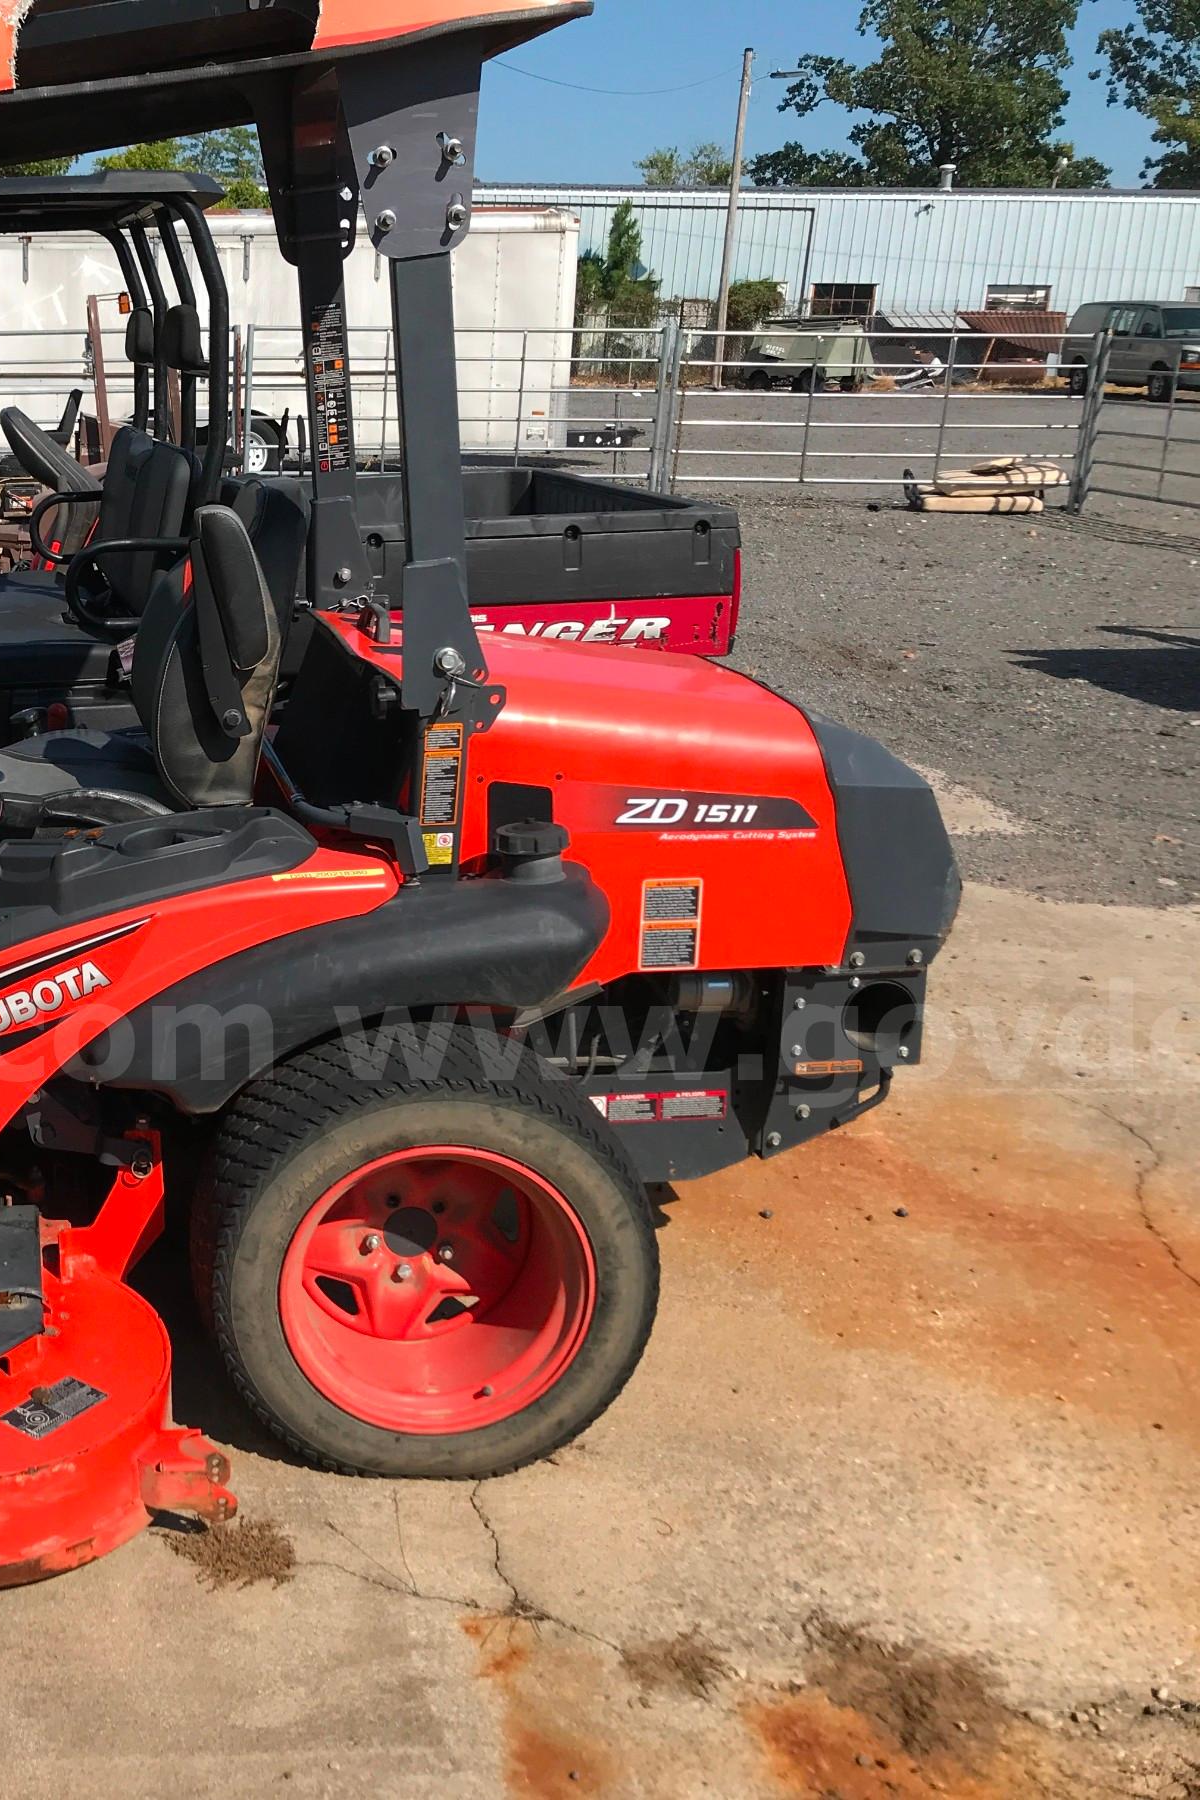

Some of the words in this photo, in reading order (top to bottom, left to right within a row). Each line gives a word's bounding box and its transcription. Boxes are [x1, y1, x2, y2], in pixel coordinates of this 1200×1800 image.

[474, 617, 672, 642] NGER
[615, 798, 689, 824] ZD
[693, 804, 759, 823] 1511
[659, 832, 729, 841] Aerodynamic
[733, 831, 774, 841] Cutting
[777, 830, 817, 840] System
